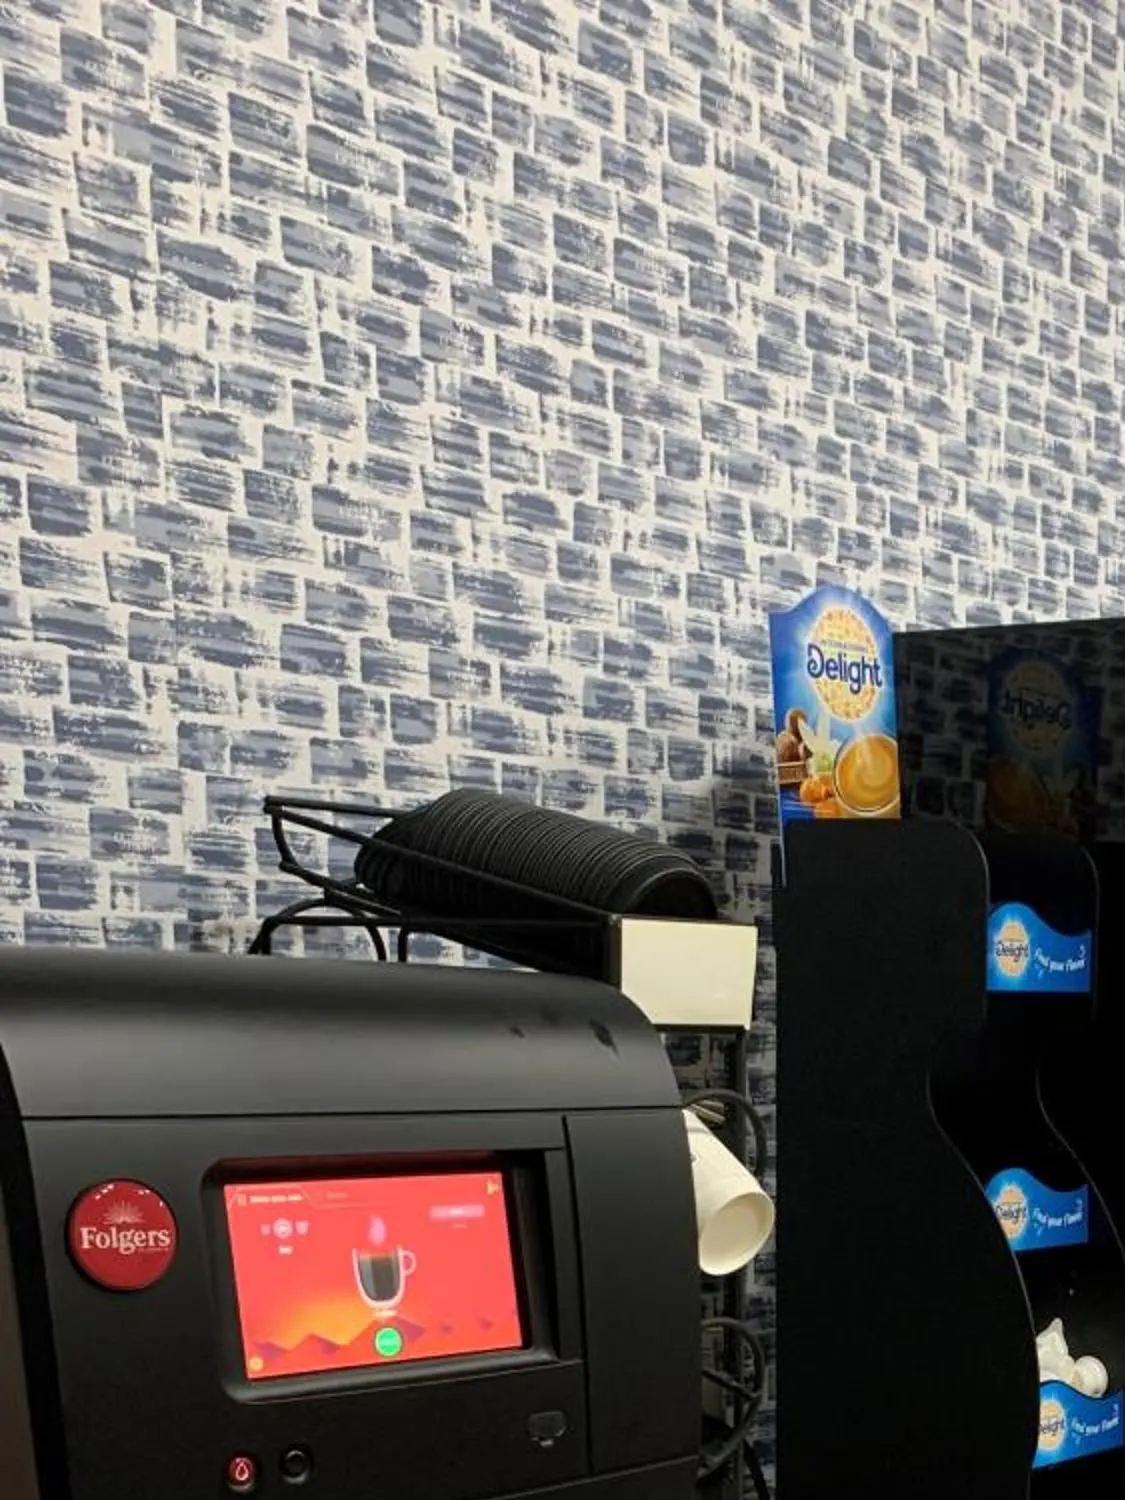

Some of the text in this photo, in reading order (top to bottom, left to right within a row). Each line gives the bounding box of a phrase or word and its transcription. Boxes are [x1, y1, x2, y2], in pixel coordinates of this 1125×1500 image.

[807, 642, 883, 694] Delight
[996, 941, 1029, 962] Delight
[79, 1225, 171, 1255] Folgers
[1039, 1417, 1065, 1436] elight
